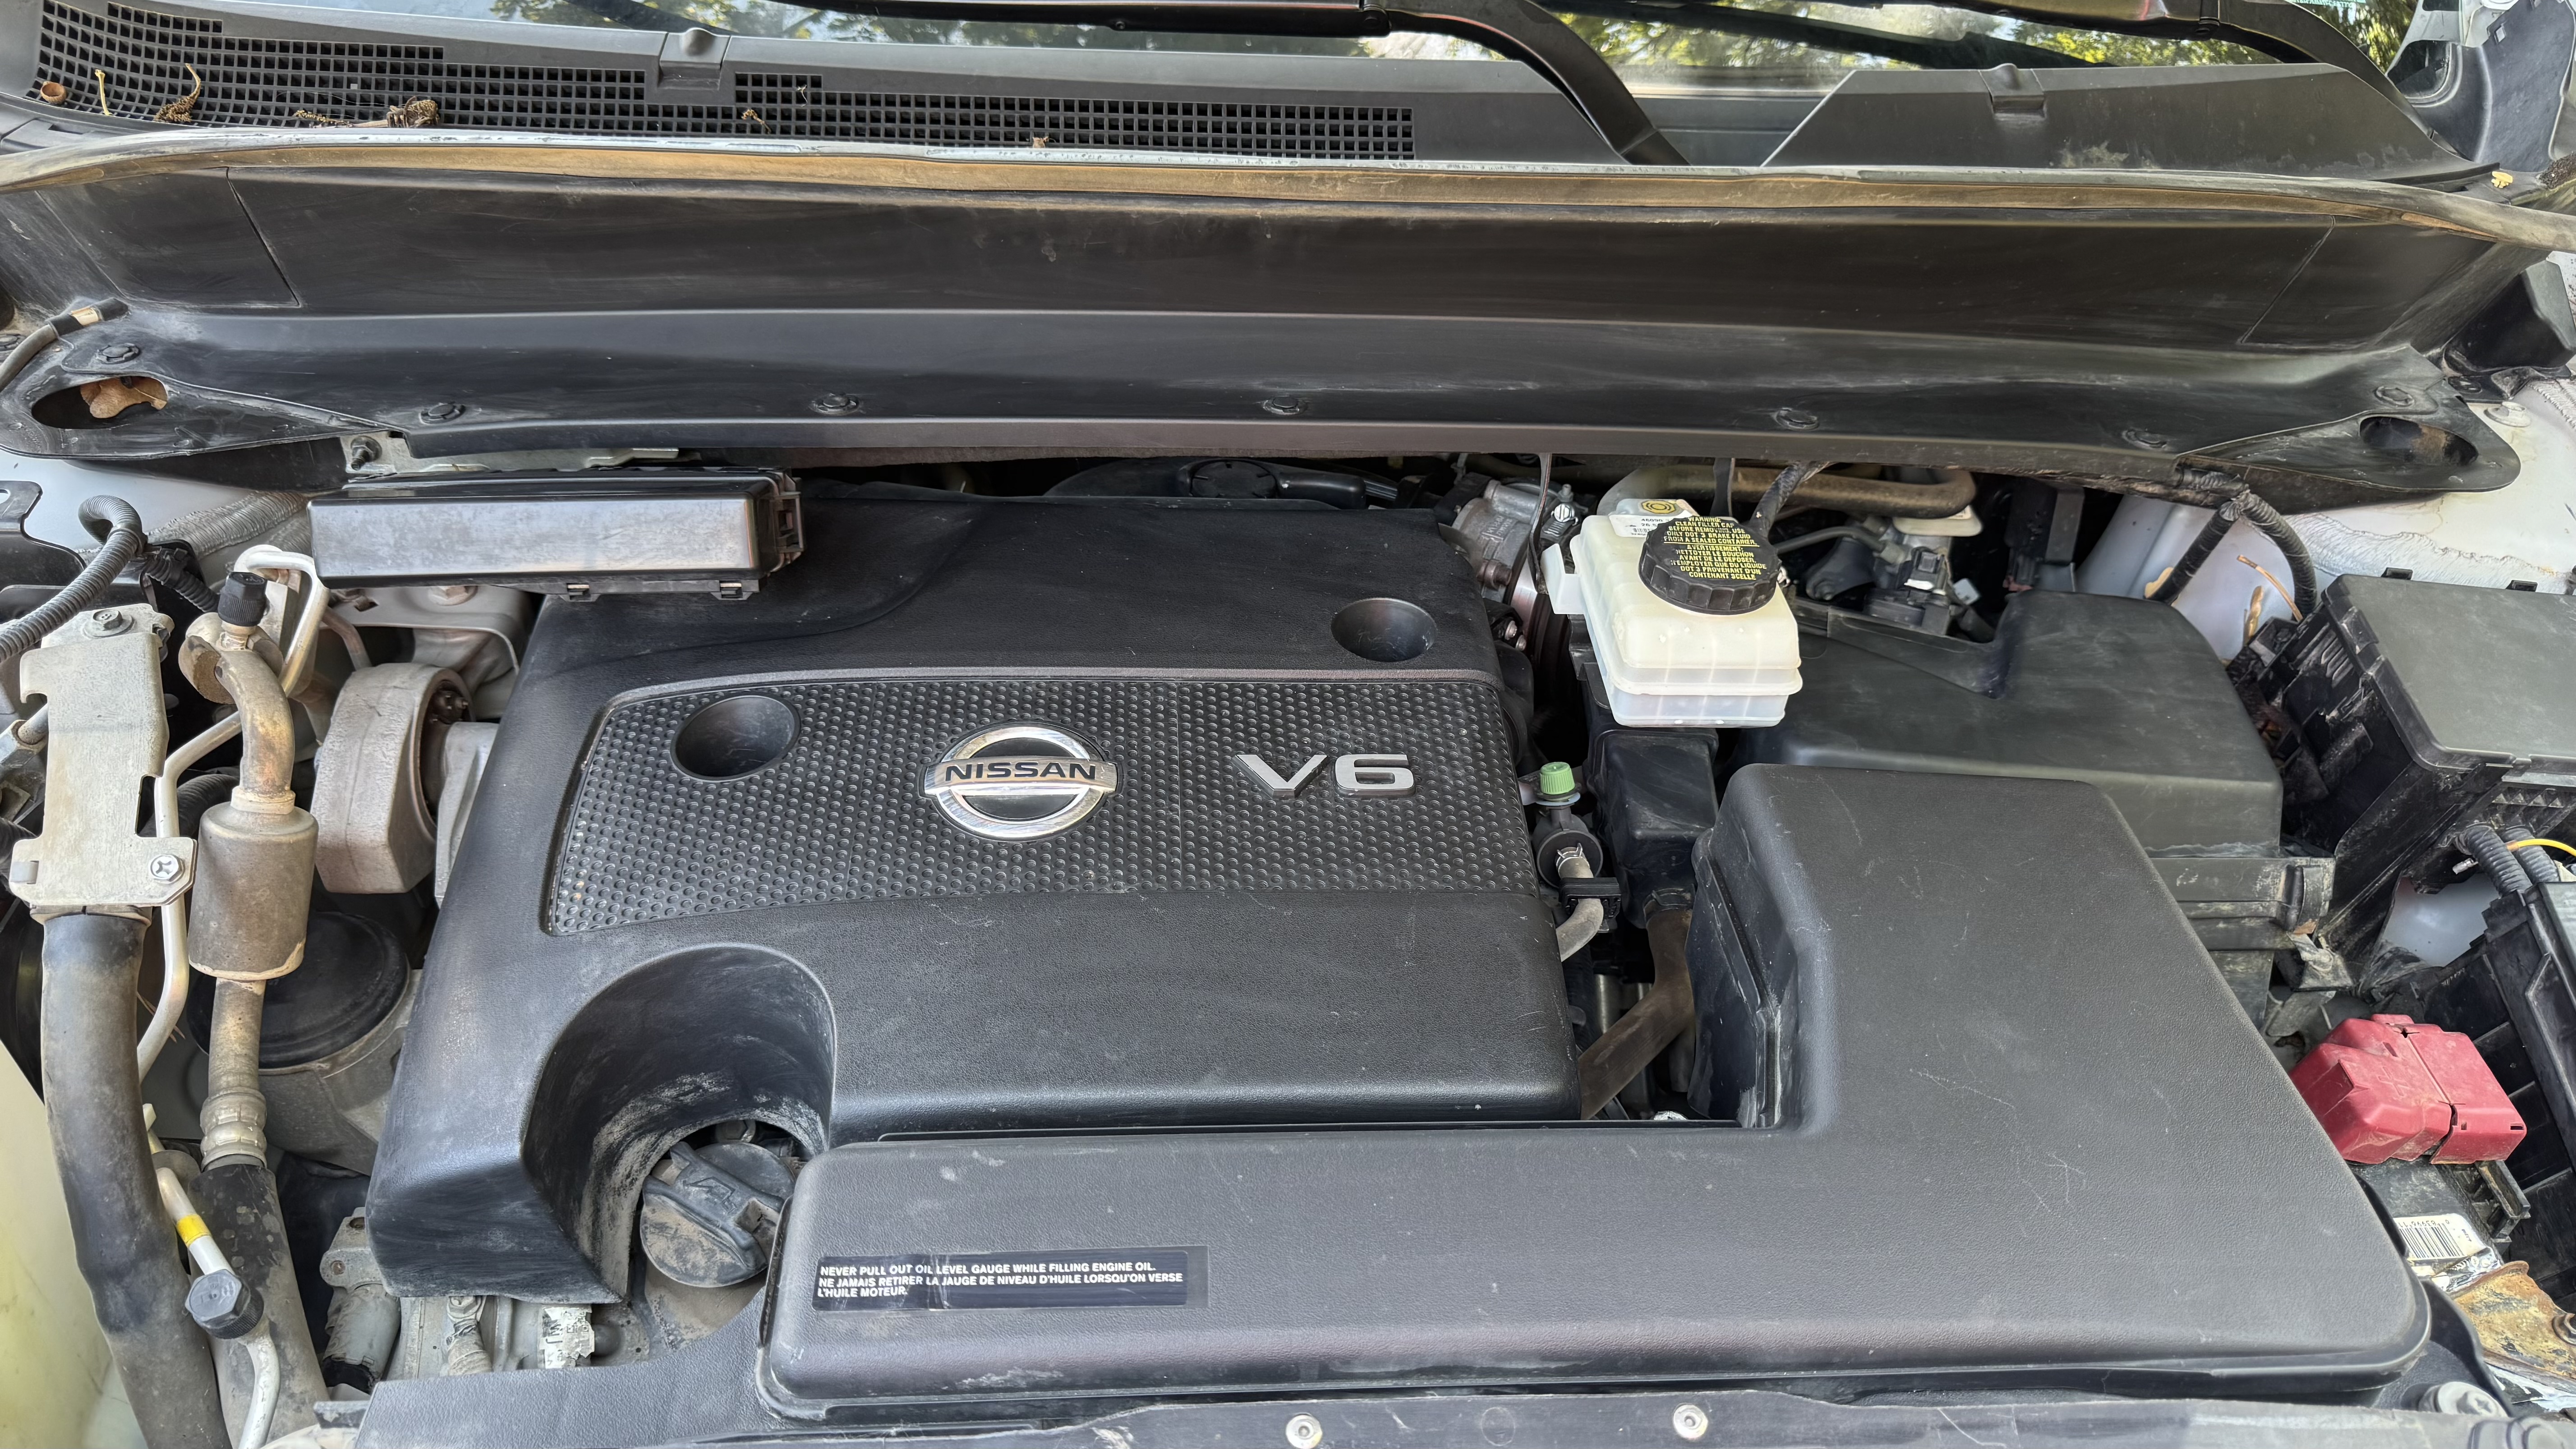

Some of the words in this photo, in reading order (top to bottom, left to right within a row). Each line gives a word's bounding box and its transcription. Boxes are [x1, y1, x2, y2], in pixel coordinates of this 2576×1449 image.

[945, 762, 1096, 782] NISSAN
[1233, 754, 1415, 797] V6
[820, 1266, 857, 1276] NEVER
[860, 1265, 887, 1276] PULL
[890, 1265, 913, 1275] OUT
[915, 1265, 933, 1274] OIL
[936, 1265, 968, 1275] LEVEL
[971, 1264, 1010, 1274] GAUGE
[1013, 1263, 1046, 1273] WHILE
[1049, 1263, 1089, 1273] FILLING
[1092, 1262, 1132, 1272] ENGINE
[1135, 1262, 1157, 1271] OIL.
[819, 1278, 834, 1288] NE
[837, 1277, 876, 1288] JAMAIS
[879, 1276, 923, 1287] RETIRER
[926, 1276, 939, 1286] LA
[942, 1276, 977, 1286] JAUGE
[979, 1275, 995, 1285] DE
[997, 1275, 1036, 1285] NIVEAU
[1039, 1274, 1082, 1284] D'HUILE
[1084, 1273, 1146, 1283] LORSQU'ON
[1148, 1273, 1183, 1283] VERSE
[817, 1288, 858, 1297] L'HUILE
[860, 1287, 909, 1297] MOTEUR.
